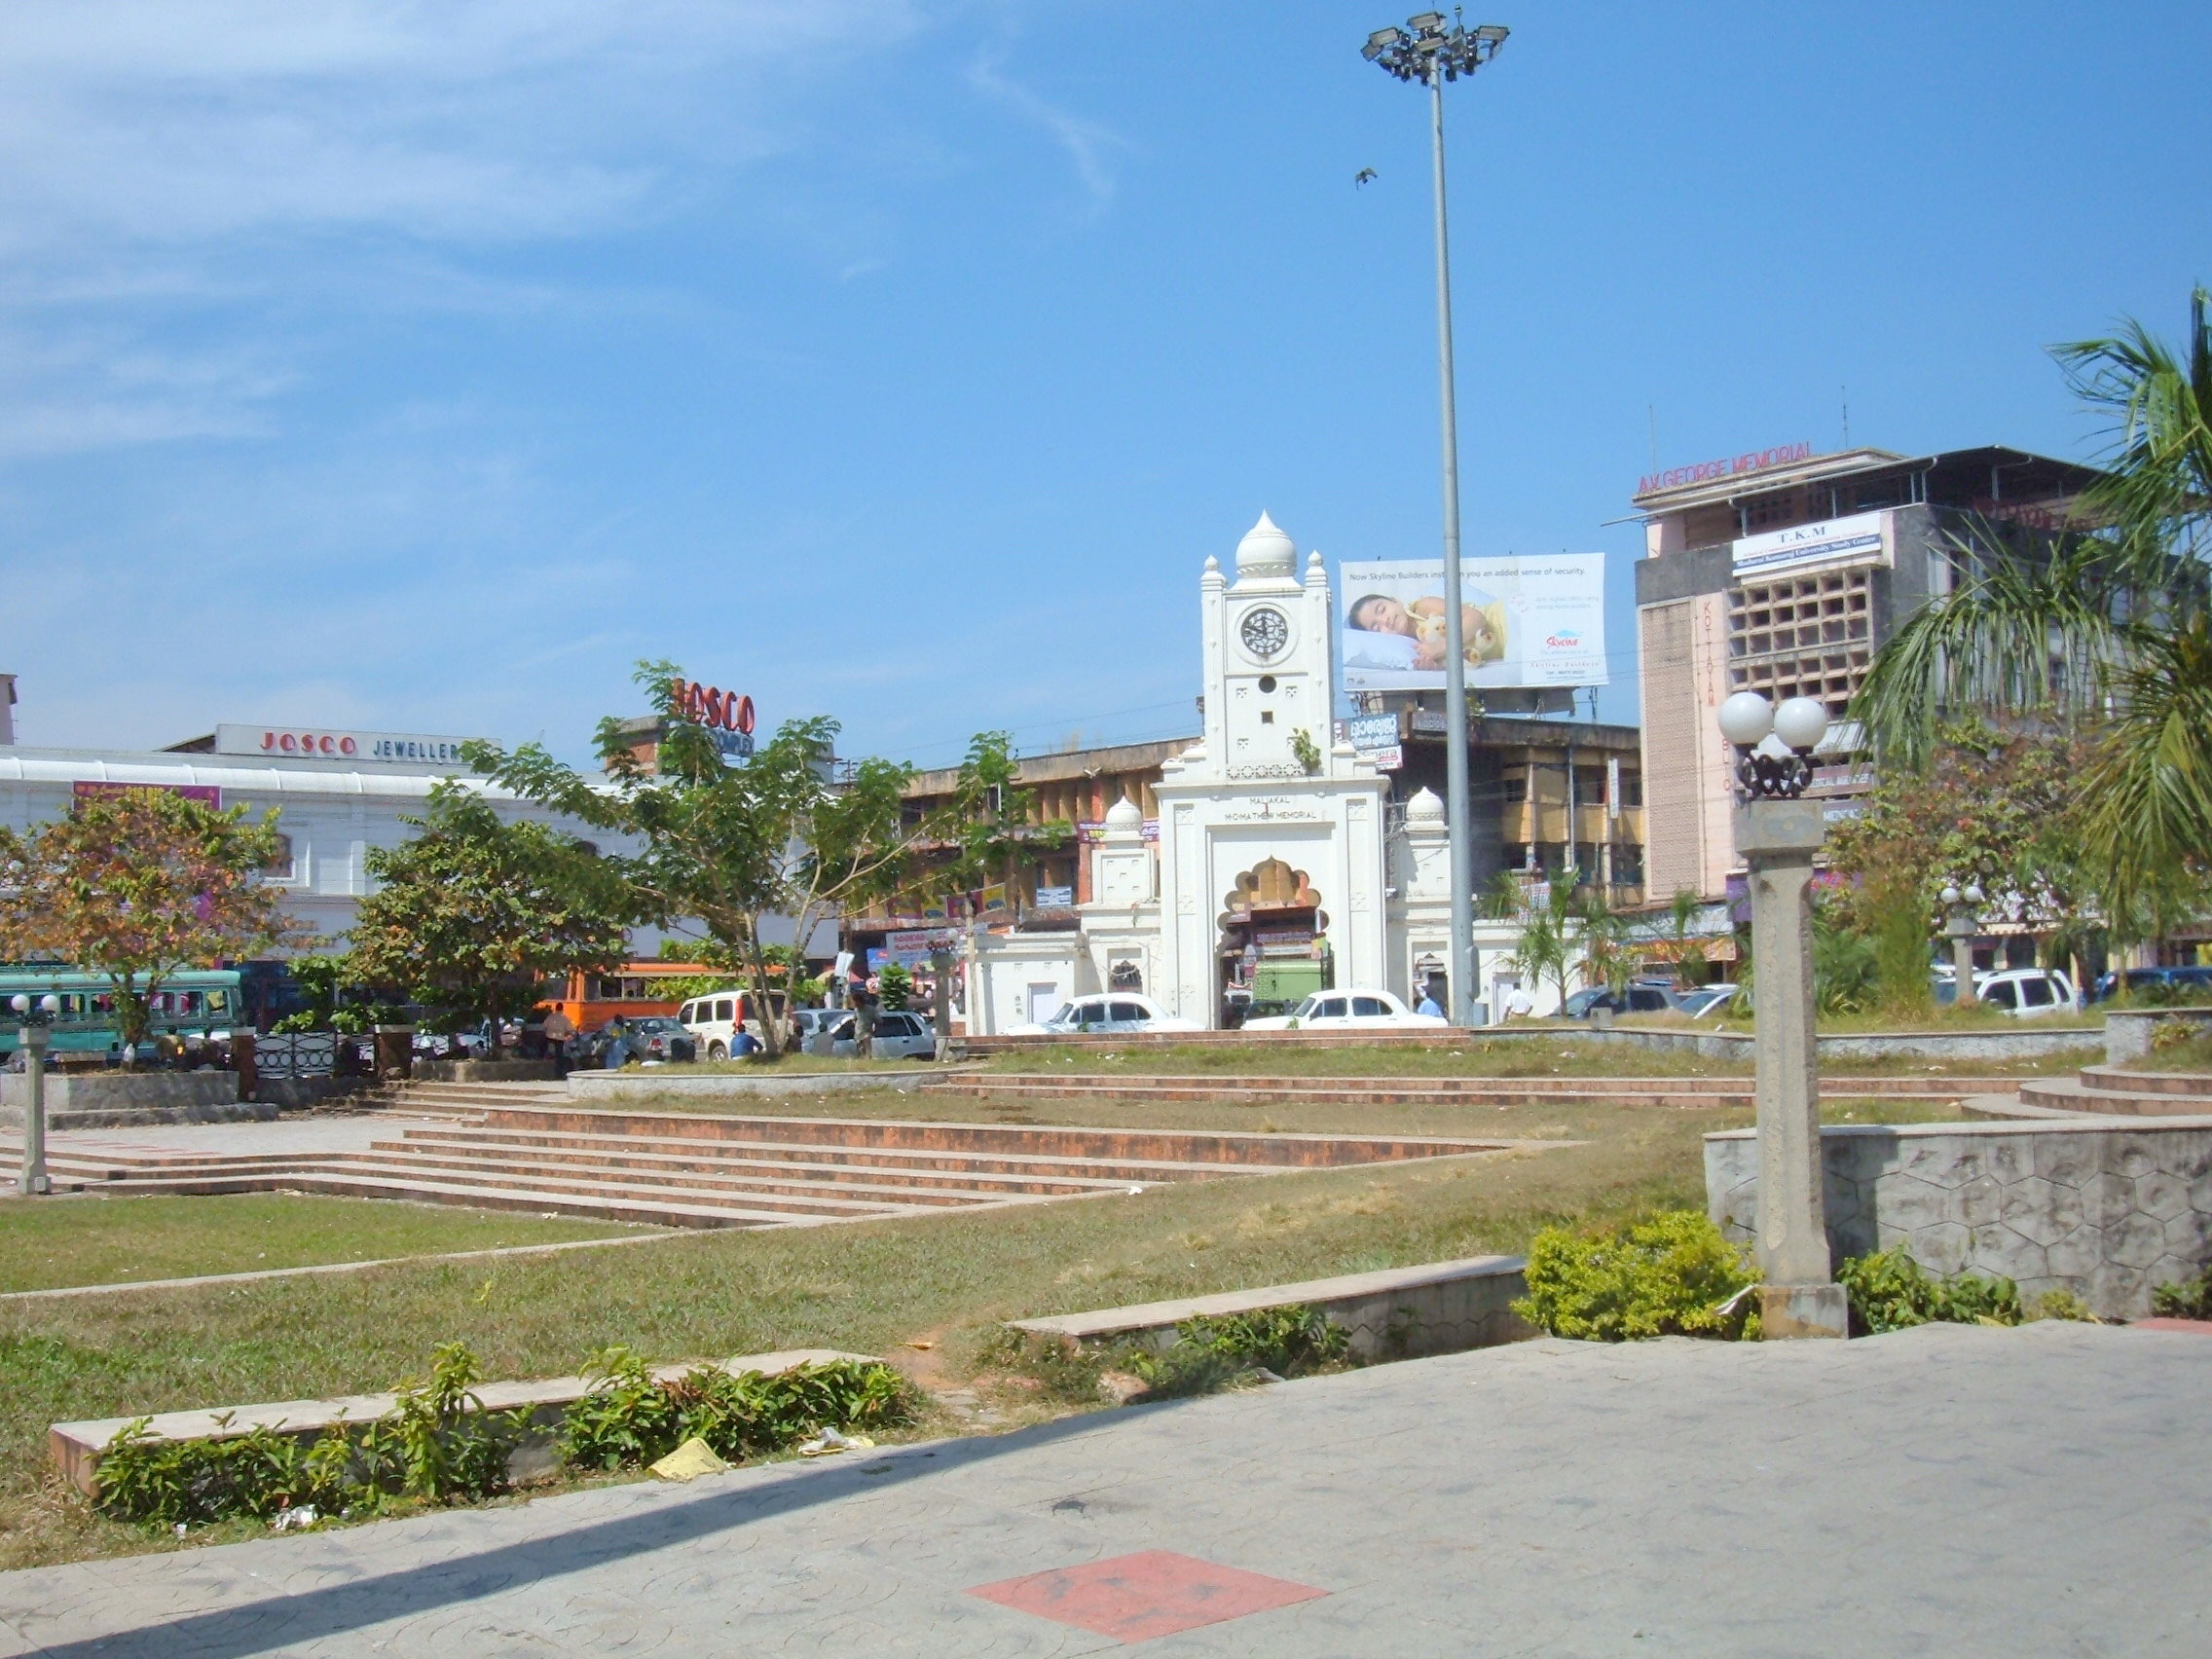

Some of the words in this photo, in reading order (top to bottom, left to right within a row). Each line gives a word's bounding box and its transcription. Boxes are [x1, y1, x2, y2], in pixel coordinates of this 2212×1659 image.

[1663, 459, 1727, 488] GEORGE
[1731, 441, 1809, 473] MEMORIAL
[1777, 526, 1825, 543] T.K.M
[1795, 544, 1829, 558] University
[1369, 571, 1397, 582] Skyline
[1398, 570, 1428, 580] Builders
[1494, 569, 1519, 577] added
[1703, 601, 1715, 706] KOTTAYAM
[260, 732, 357, 755] JOSCO
[373, 739, 464, 759] JEWELLER
[1276, 810, 1317, 820] MEMORIAL
